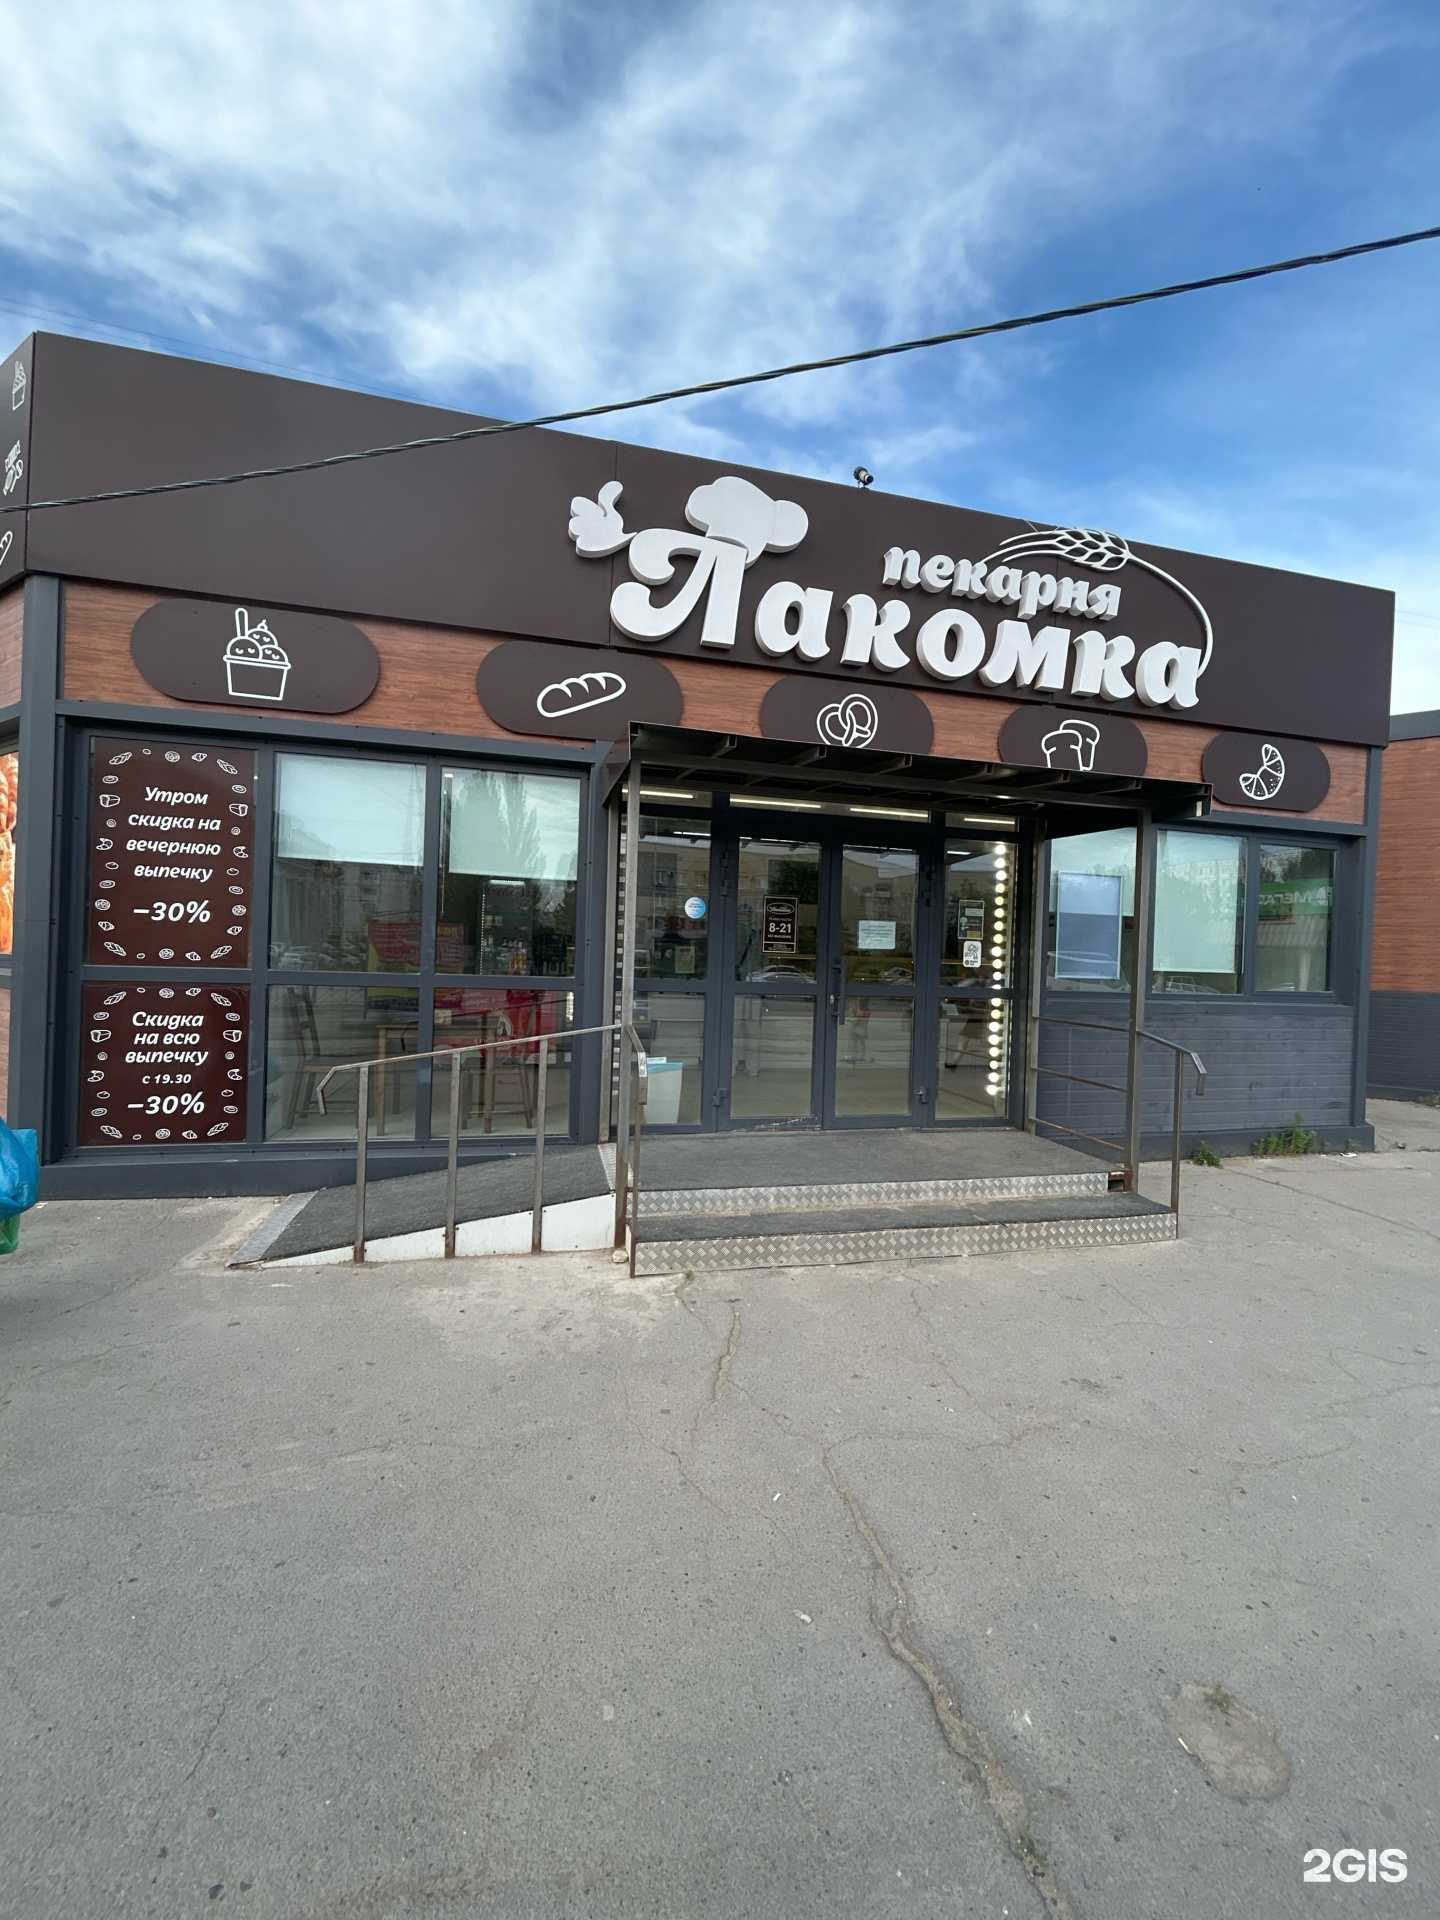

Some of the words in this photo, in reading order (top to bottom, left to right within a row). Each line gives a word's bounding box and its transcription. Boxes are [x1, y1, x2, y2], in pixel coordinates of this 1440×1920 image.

[882, 546, 1121, 620] пекарня
[610, 528, 1204, 711] Лакомка
[144, 786, 208, 805] Утром
[128, 813, 194, 830] скидка
[198, 817, 221, 831] на
[126, 839, 221, 856] вечернюю
[134, 864, 213, 883] выпечку
[769, 922, 791, 933] 8-21
[132, 1011, 204, 1030] Скидка
[134, 1032, 159, 1045] на
[163, 1032, 200, 1045] всю
[125, 1051, 208, 1066] выпечку
[142, 1075, 150, 1084] с
[154, 1074, 192, 1084] 19.30
